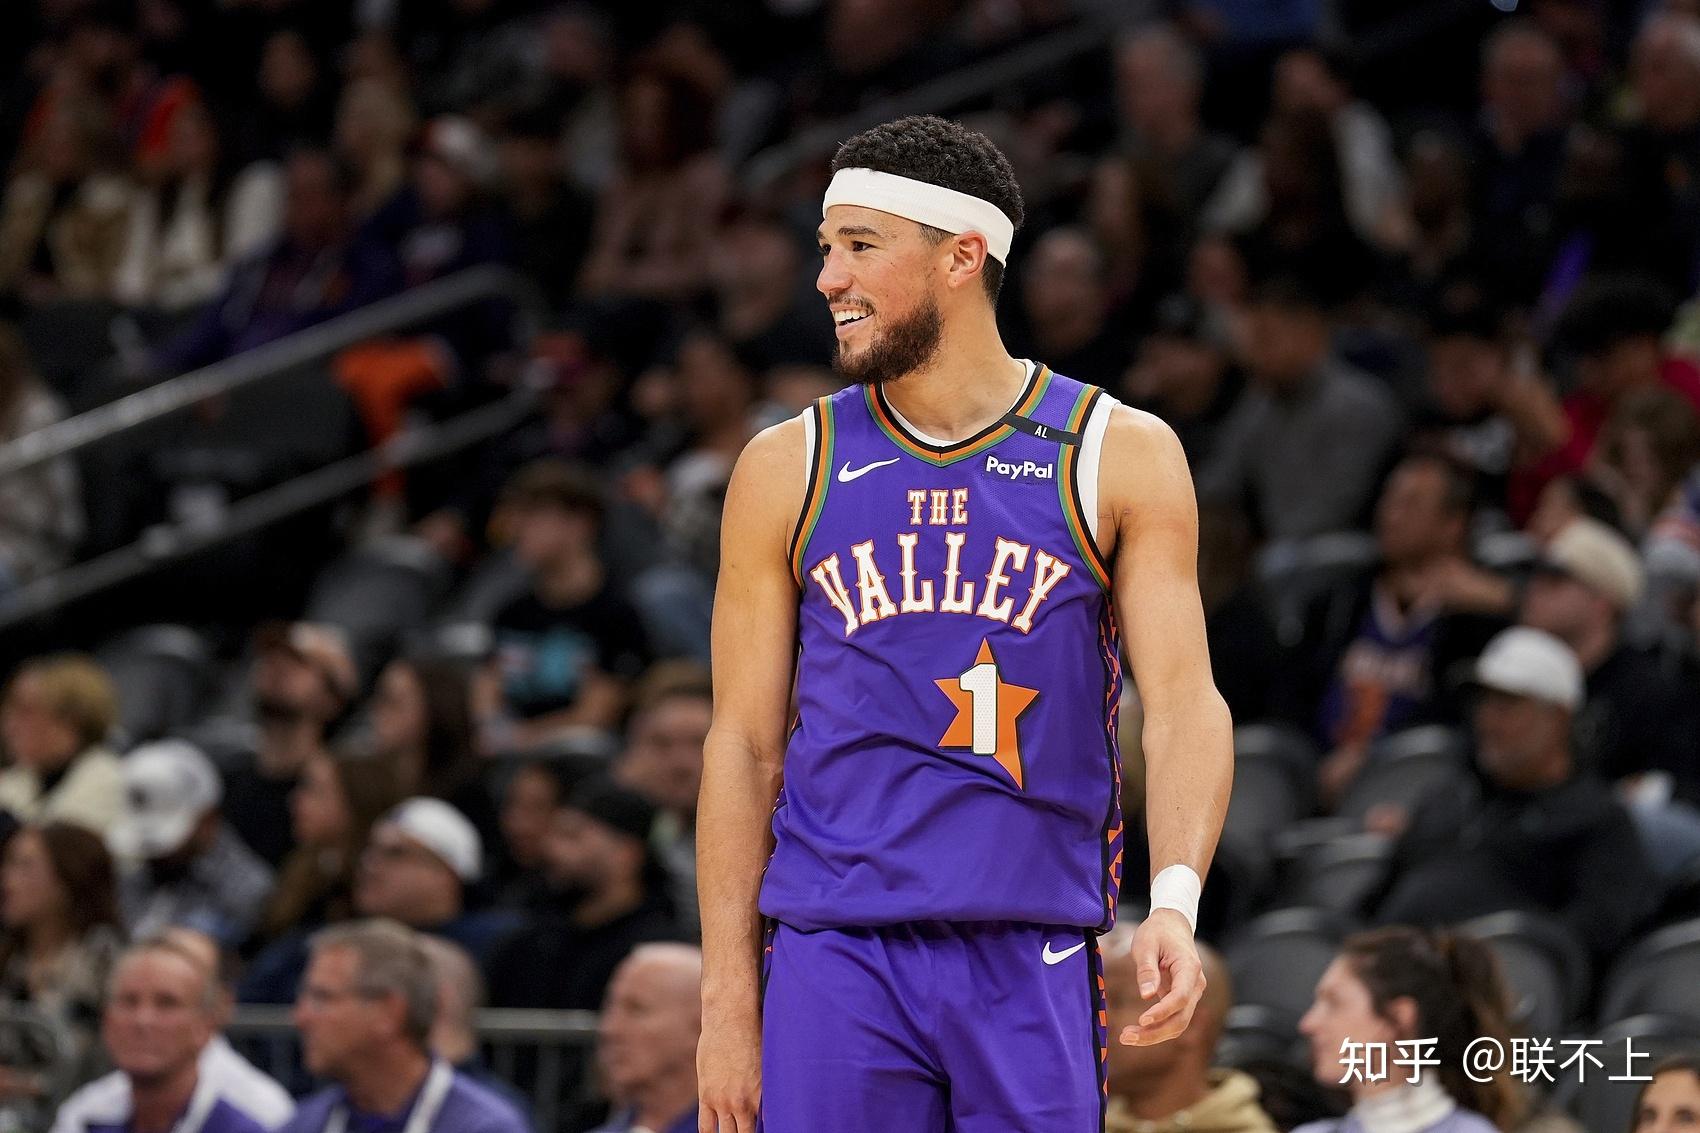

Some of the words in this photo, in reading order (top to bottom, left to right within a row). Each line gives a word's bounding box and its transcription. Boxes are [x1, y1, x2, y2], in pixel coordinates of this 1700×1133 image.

[1034, 425, 1048, 439] AL
[986, 455, 1053, 480] PayPal
[907, 487, 969, 526] THE
[810, 532, 1072, 638] VALLEY
[958, 662, 999, 756] 1
